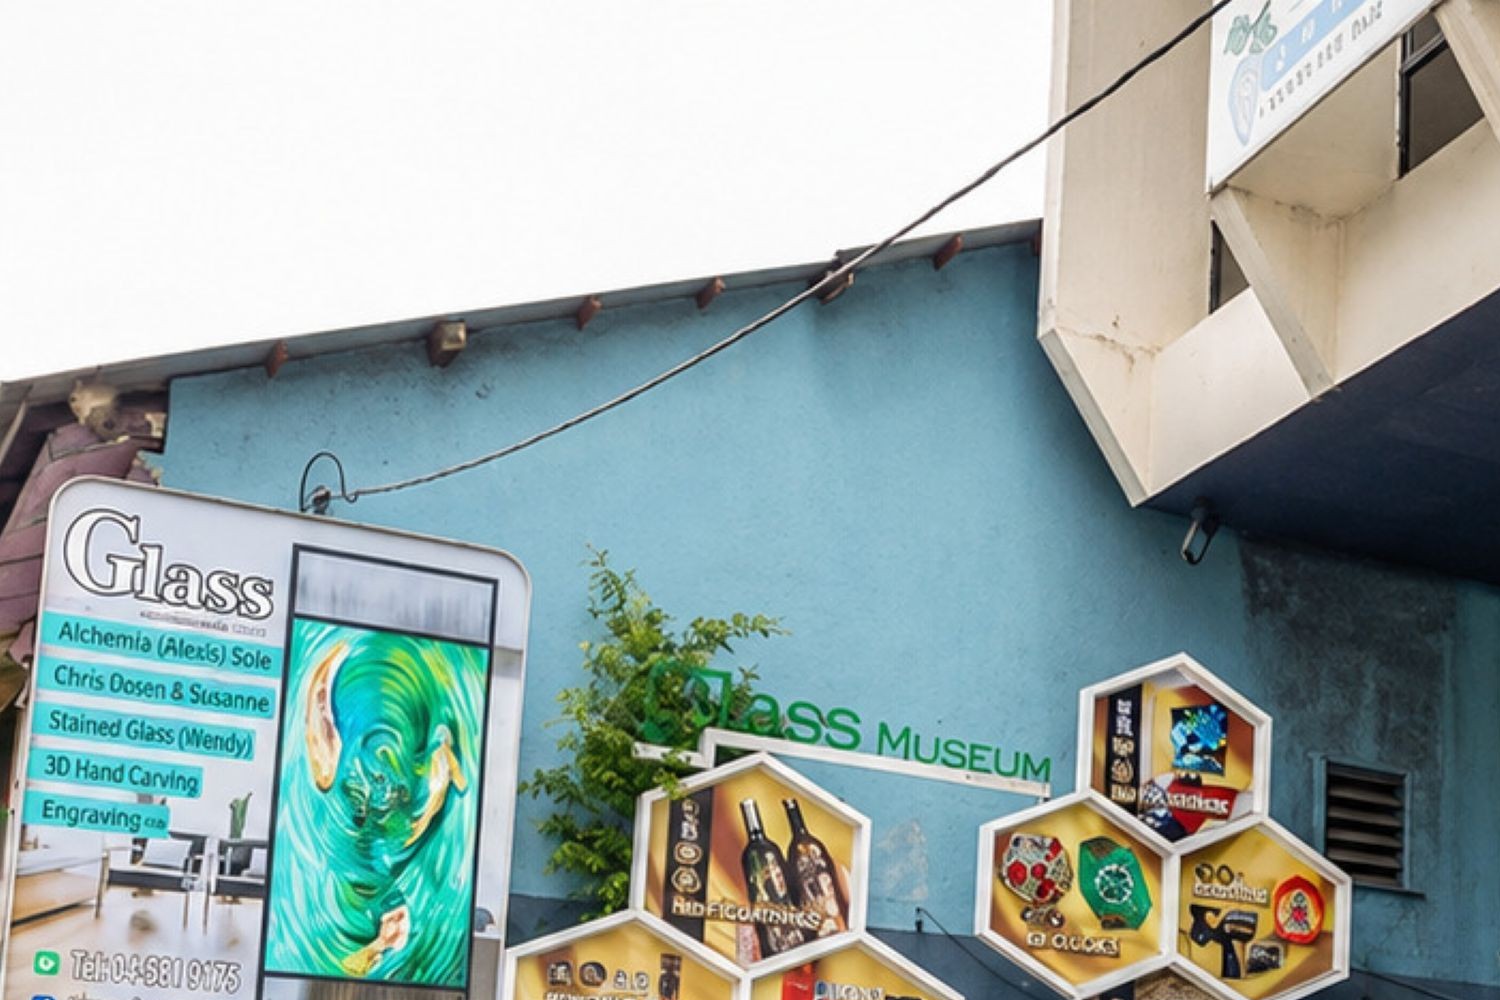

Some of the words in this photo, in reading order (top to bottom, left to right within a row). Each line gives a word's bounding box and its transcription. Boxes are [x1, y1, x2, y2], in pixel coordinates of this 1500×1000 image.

[63, 507, 275, 620] Glass
[58, 620, 153, 654] Alchemia
[231, 648, 272, 671] Sole
[54, 664, 105, 692] Chris
[170, 680, 184, 701] &
[190, 683, 270, 713] Susanne
[49, 709, 122, 738] Stained
[126, 719, 175, 746] Glass
[178, 726, 253, 759] (Wendy)
[876, 721, 1051, 782] MUSEUM
[44, 754, 71, 777] 3D
[75, 761, 124, 784] Hand
[128, 765, 199, 796] Carving
[42, 799, 142, 833] Engraving
[70, 950, 108, 983] Tel:
